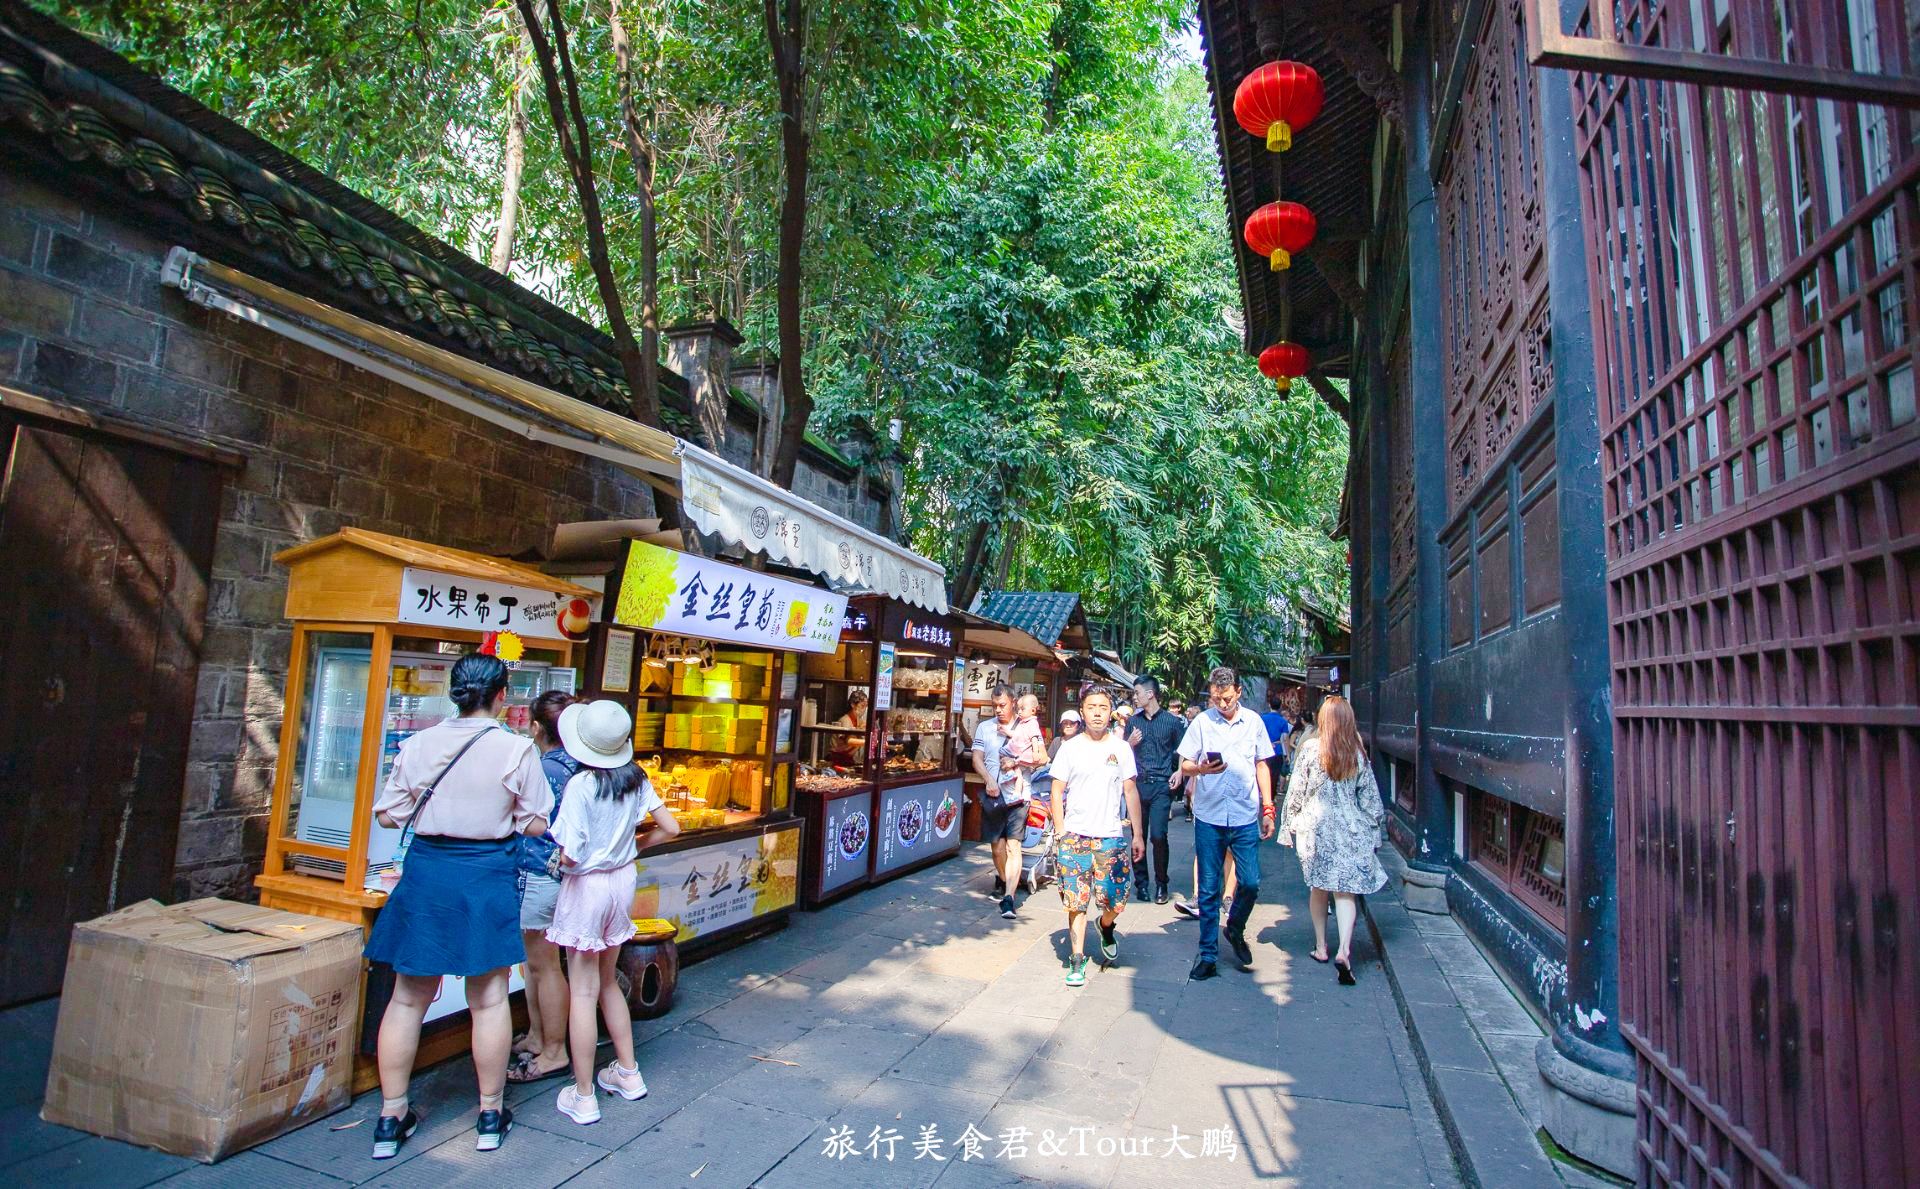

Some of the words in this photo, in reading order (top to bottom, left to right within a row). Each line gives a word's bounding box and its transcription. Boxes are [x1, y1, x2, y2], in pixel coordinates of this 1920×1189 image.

[417, 584, 519, 625] 水果布丁
[680, 570, 775, 631] 金丝皇菊
[681, 854, 770, 906] 金丝皇菊
